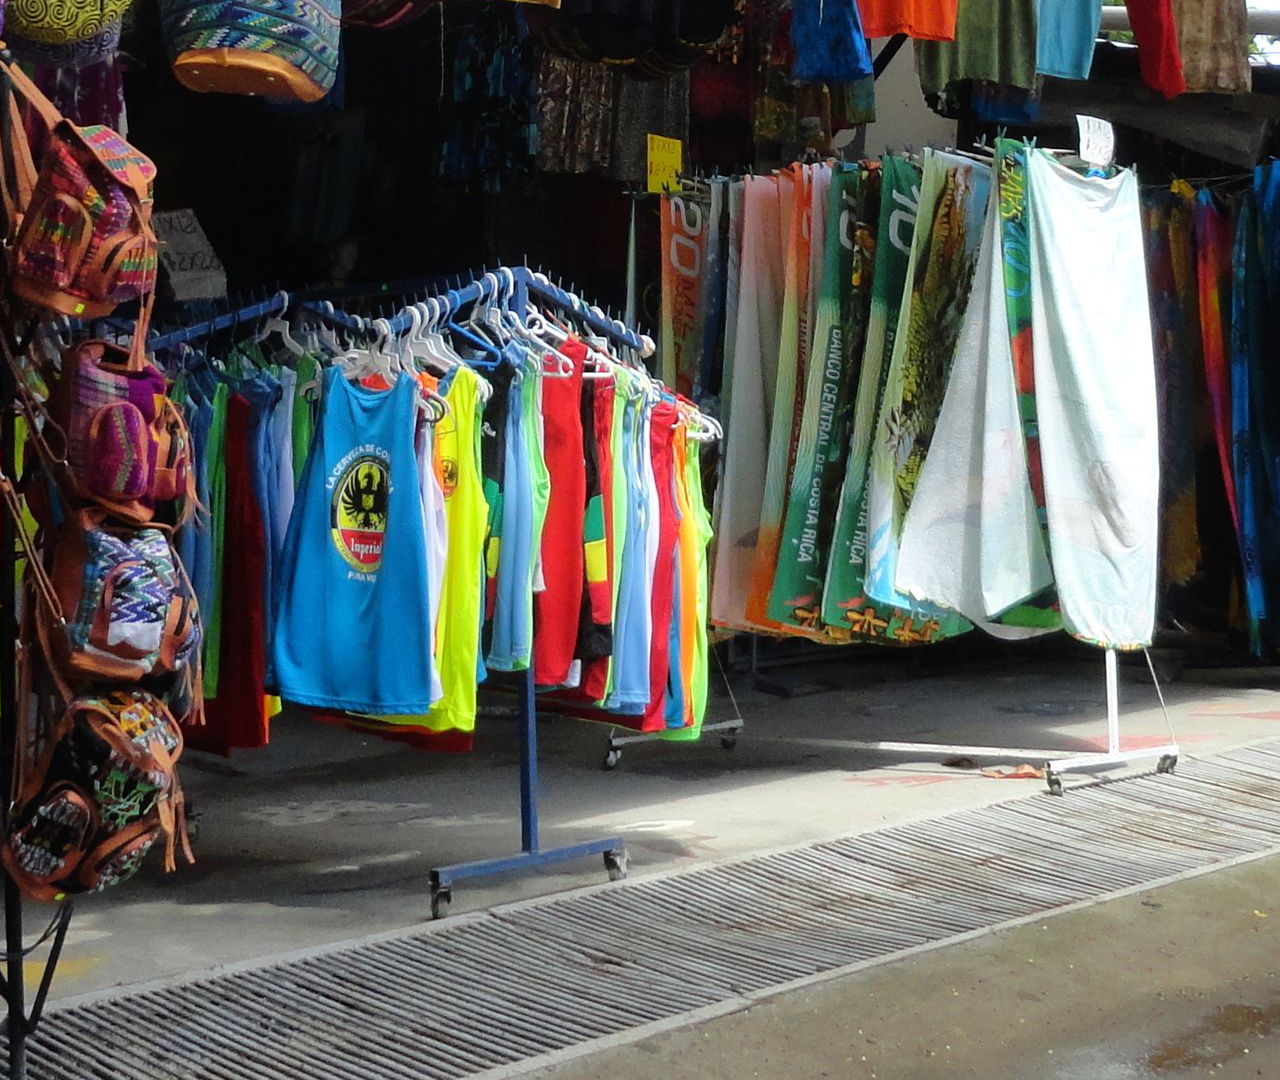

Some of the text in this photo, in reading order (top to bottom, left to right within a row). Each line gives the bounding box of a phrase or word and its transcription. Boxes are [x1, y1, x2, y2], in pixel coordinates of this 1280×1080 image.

[670, 196, 702, 278] 20
[824, 328, 842, 381] BANCO
[817, 384, 838, 447] CENTRAL
[325, 476, 337, 490] LA
[804, 479, 823, 524] COSTA
[350, 537, 383, 560] Imperial
